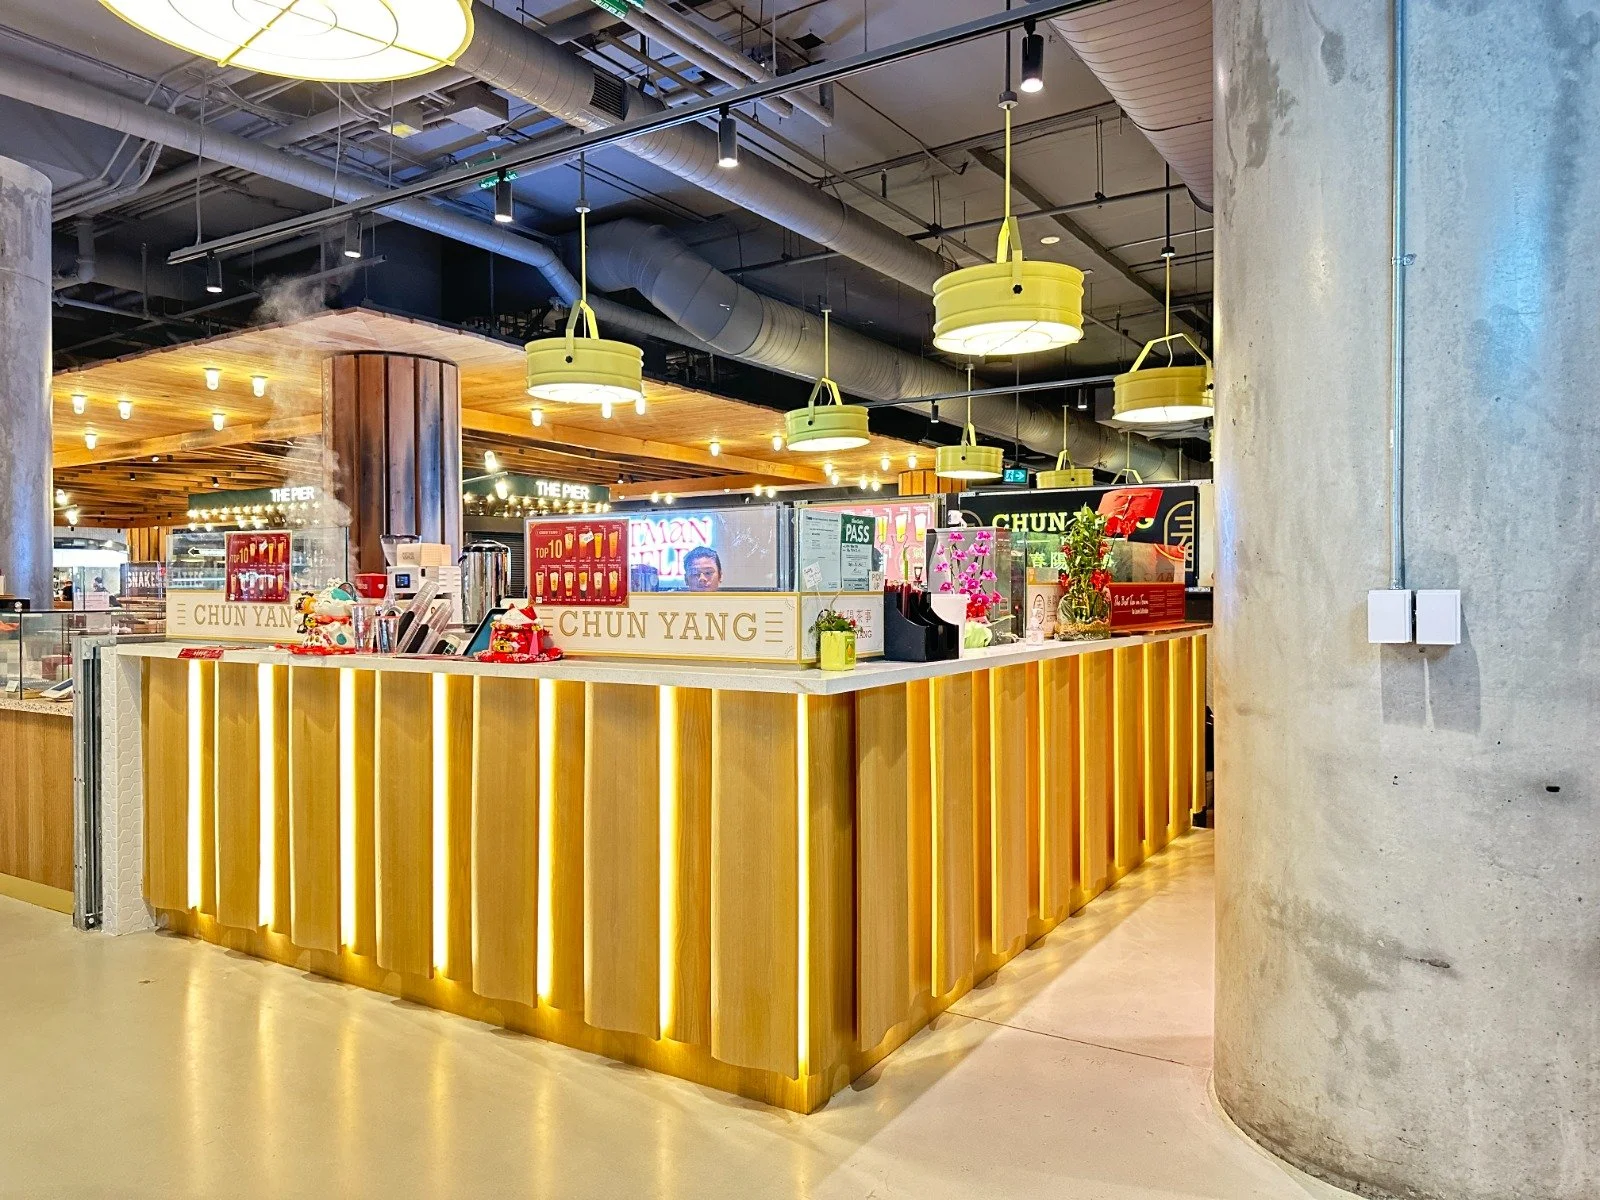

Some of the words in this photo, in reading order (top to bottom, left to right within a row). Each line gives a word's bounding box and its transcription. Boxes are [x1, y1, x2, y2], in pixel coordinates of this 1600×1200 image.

[270, 488, 291, 502] THE
[291, 486, 315, 501] PIER
[535, 480, 561, 498] THE
[562, 483, 591, 500] PIER
[992, 511, 1068, 533] CHUN
[845, 523, 870, 543] PASS
[239, 546, 249, 564] 10
[535, 547, 549, 559] TOP
[548, 539, 563, 559] 10
[194, 604, 247, 627] CHUN
[252, 605, 294, 628] YAN
[558, 610, 649, 639] CHUN
[658, 612, 758, 642] YANG
